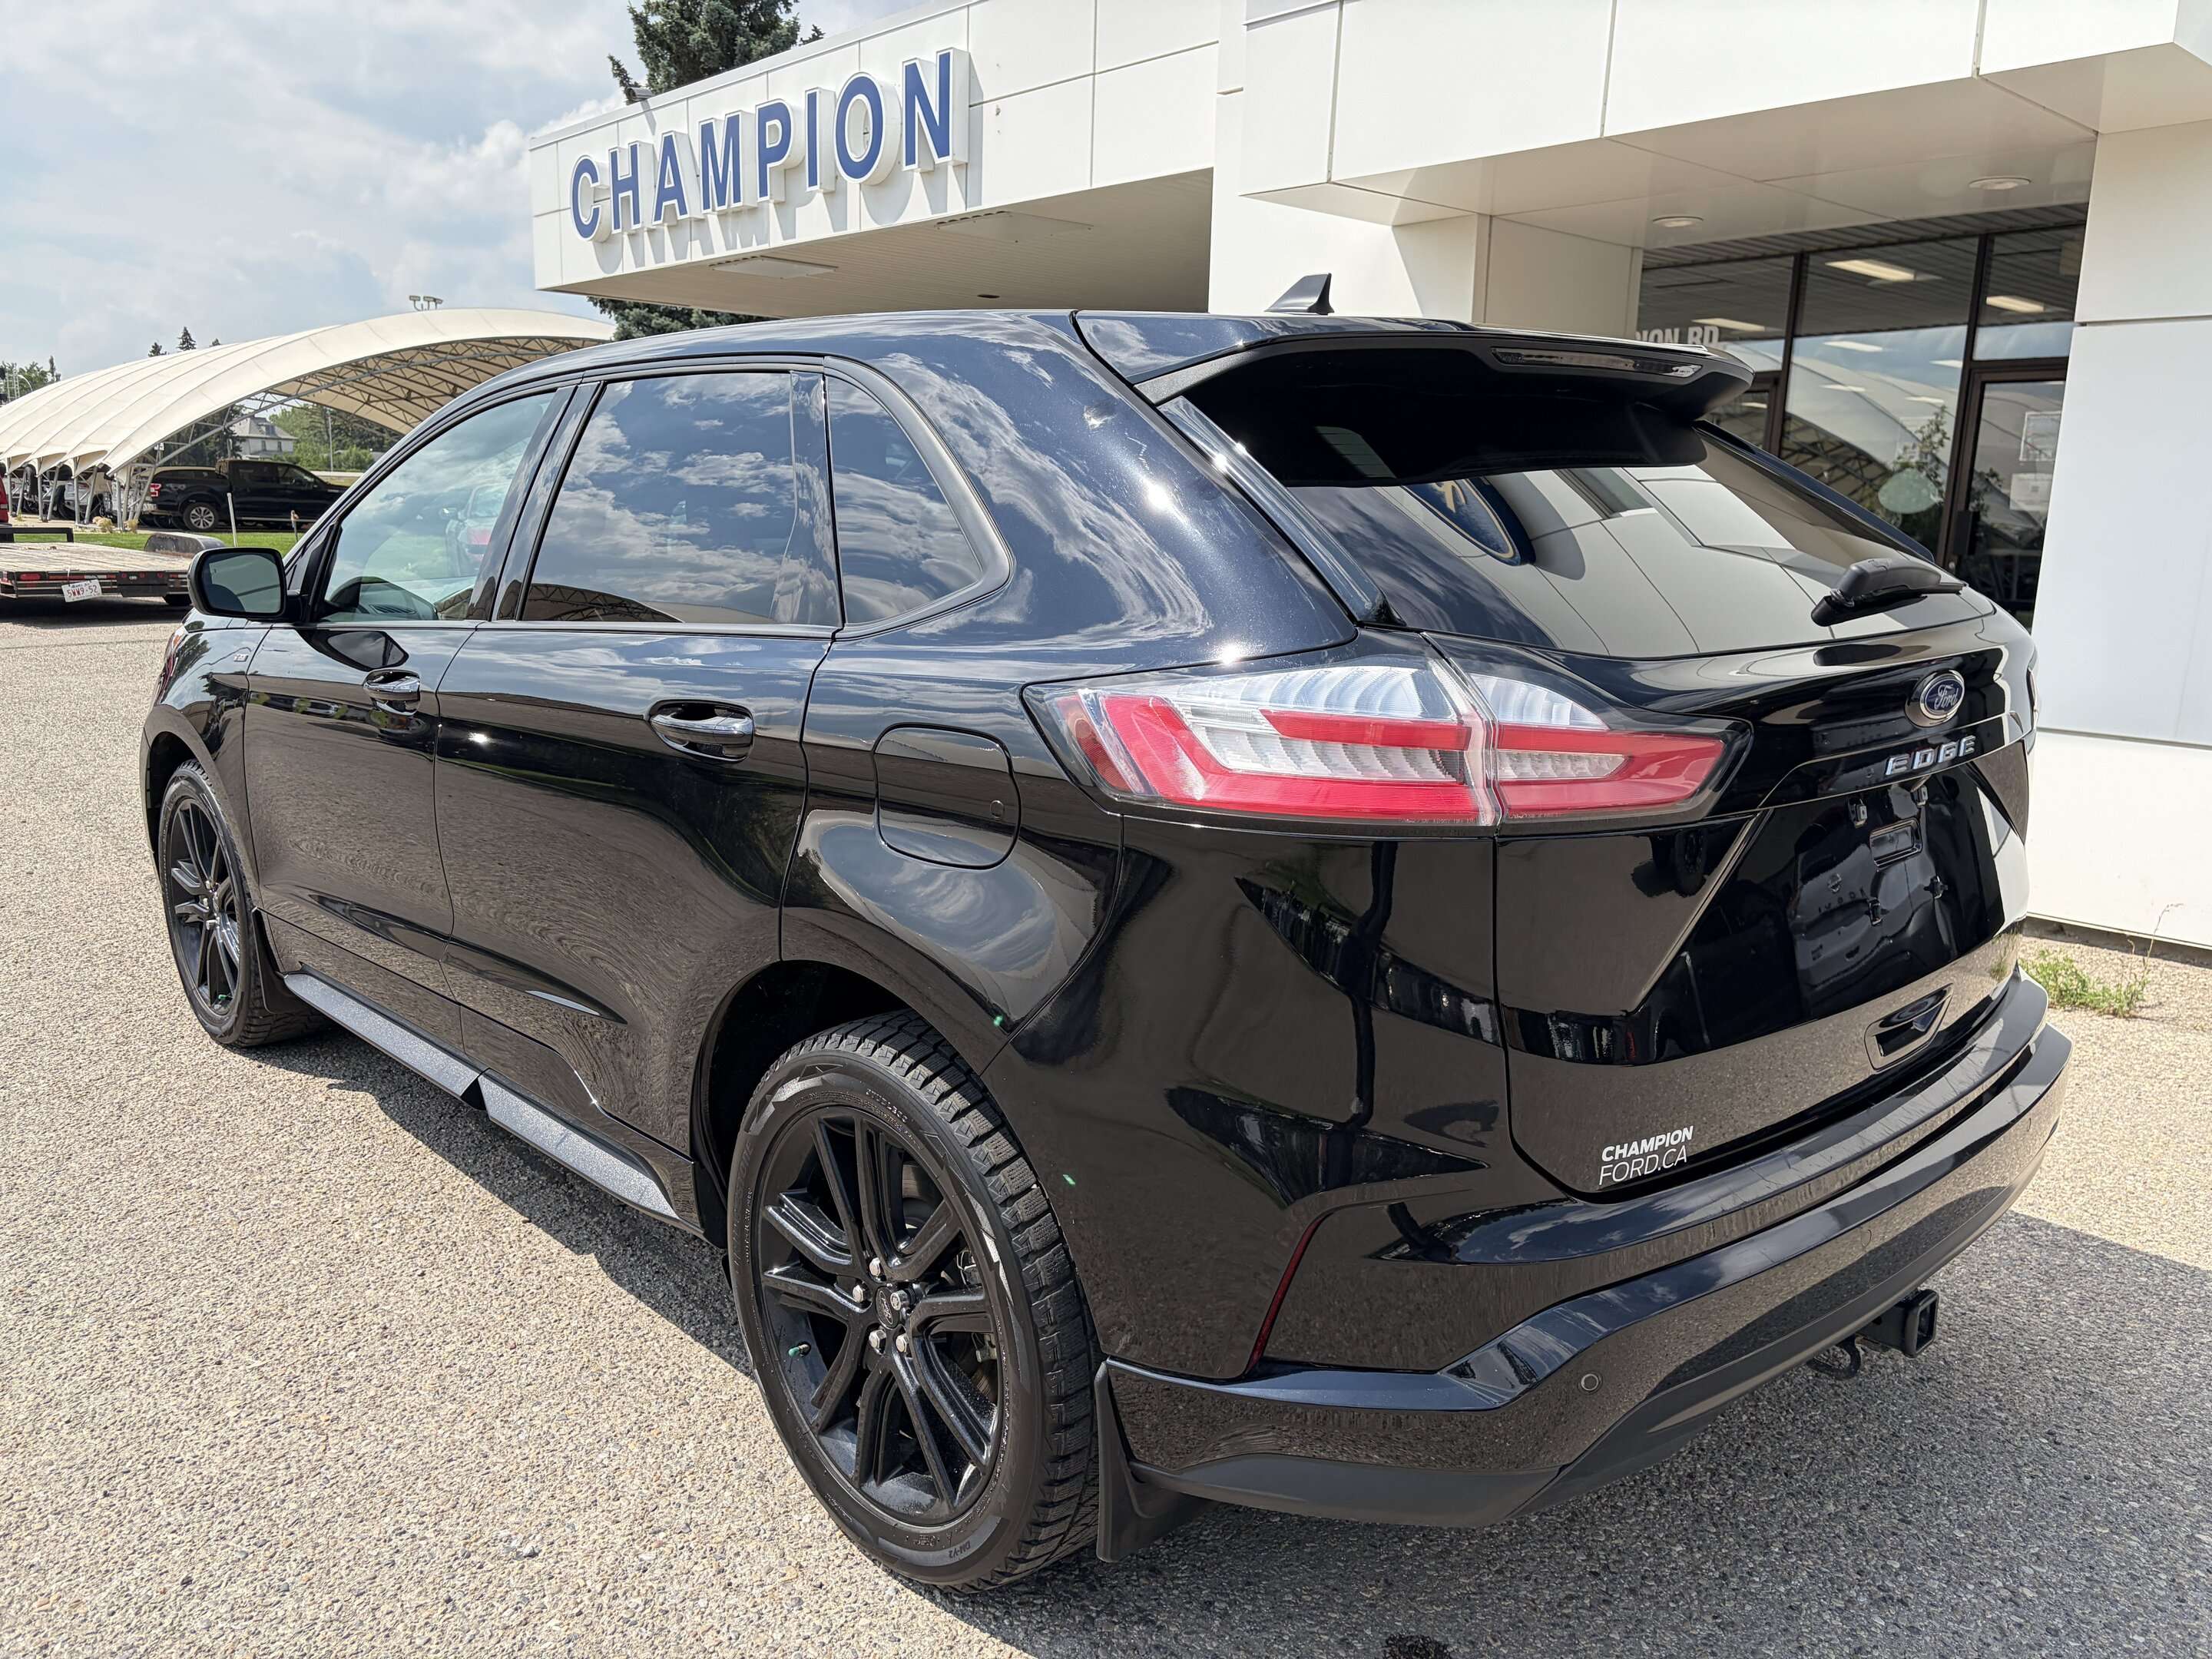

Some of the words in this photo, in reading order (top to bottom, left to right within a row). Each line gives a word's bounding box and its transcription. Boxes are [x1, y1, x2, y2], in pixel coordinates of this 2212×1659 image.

[571, 48, 959, 242] CHAMPION
[1934, 684, 1959, 710] Ford
[1886, 735, 1976, 775] EDGE
[1601, 1125, 1694, 1162] CHAMPION
[1598, 1144, 1687, 1186] FORD.CA
